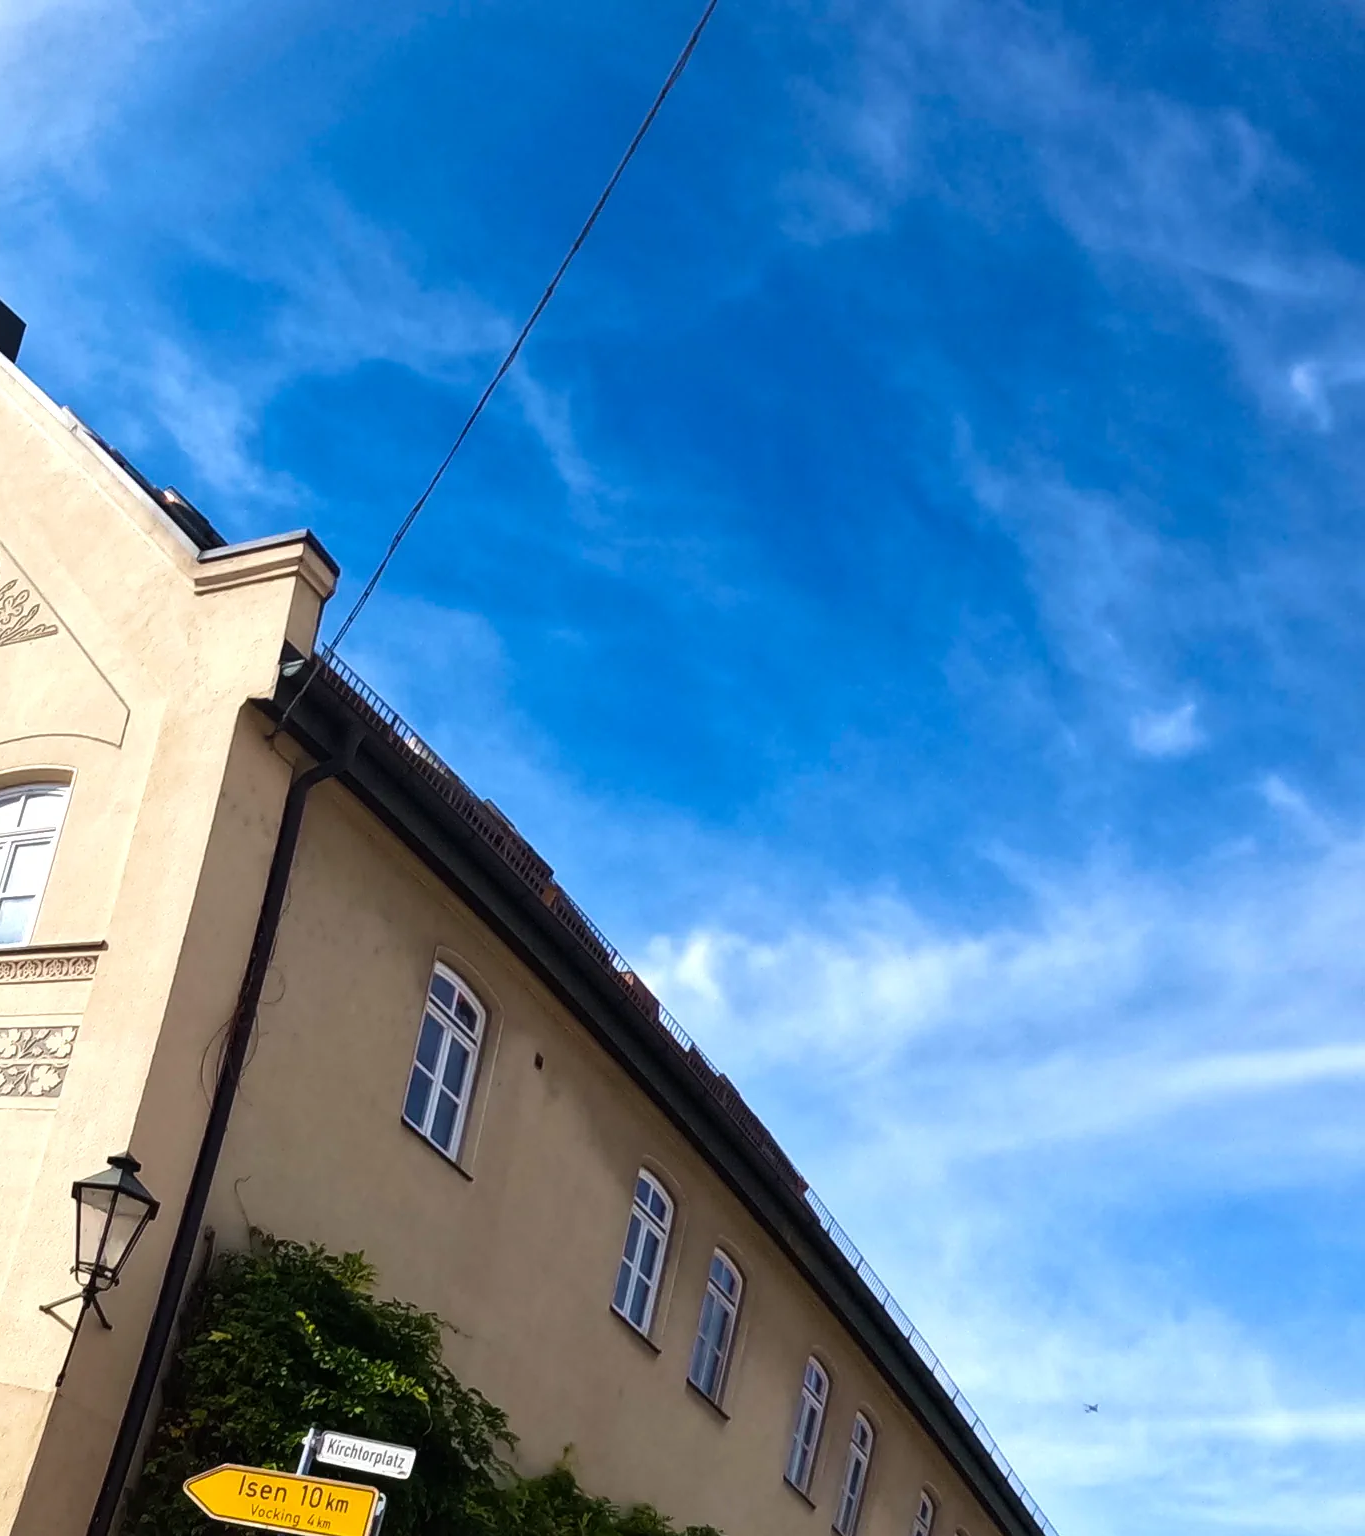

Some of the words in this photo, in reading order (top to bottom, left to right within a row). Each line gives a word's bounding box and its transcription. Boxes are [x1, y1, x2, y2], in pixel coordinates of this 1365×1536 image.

[326, 1438, 406, 1469] Kirchtorplatz
[238, 1474, 287, 1503] Isen
[301, 1484, 323, 1508] 10
[325, 1492, 350, 1514] km
[250, 1504, 300, 1528] Vocking
[307, 1515, 315, 1528] 4
[316, 1516, 331, 1530] km
